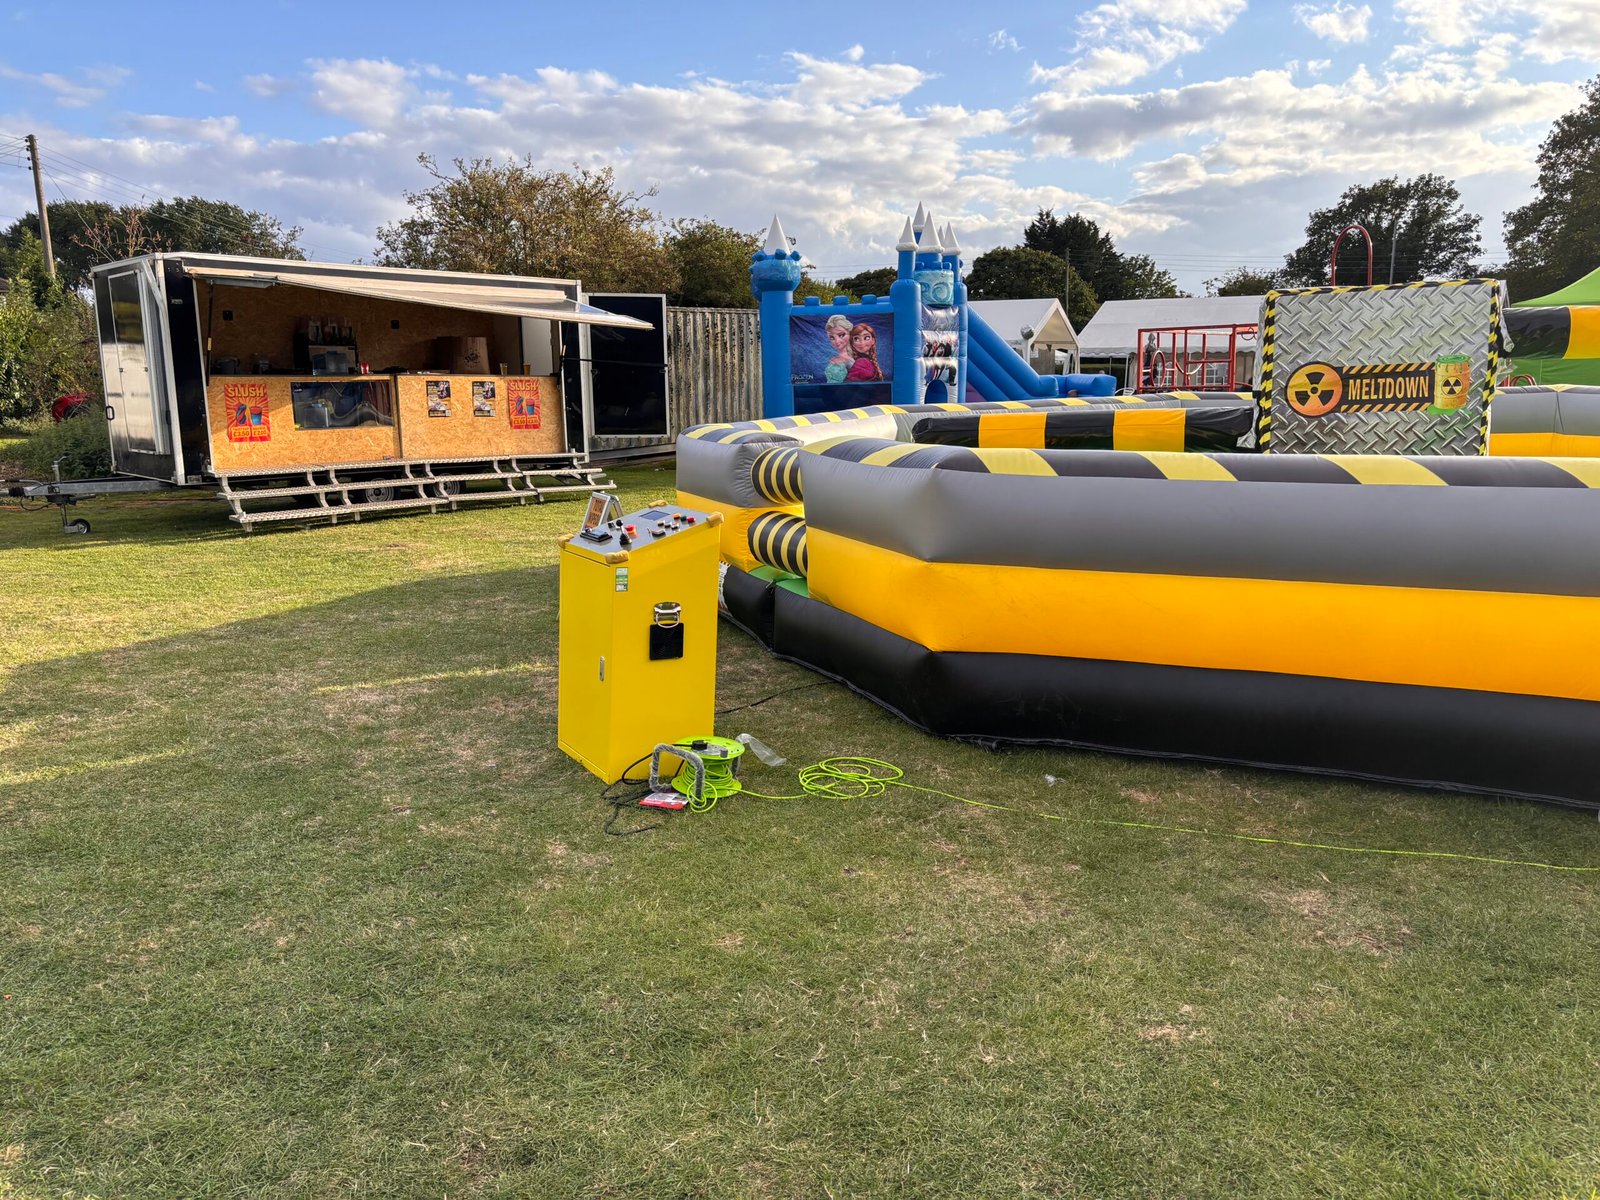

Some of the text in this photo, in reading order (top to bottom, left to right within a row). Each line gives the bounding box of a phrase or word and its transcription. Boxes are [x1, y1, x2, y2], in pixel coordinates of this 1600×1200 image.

[229, 386, 265, 397] SLUSH
[510, 382, 536, 391] SLUSH
[1348, 376, 1429, 400] MELTDOWN
